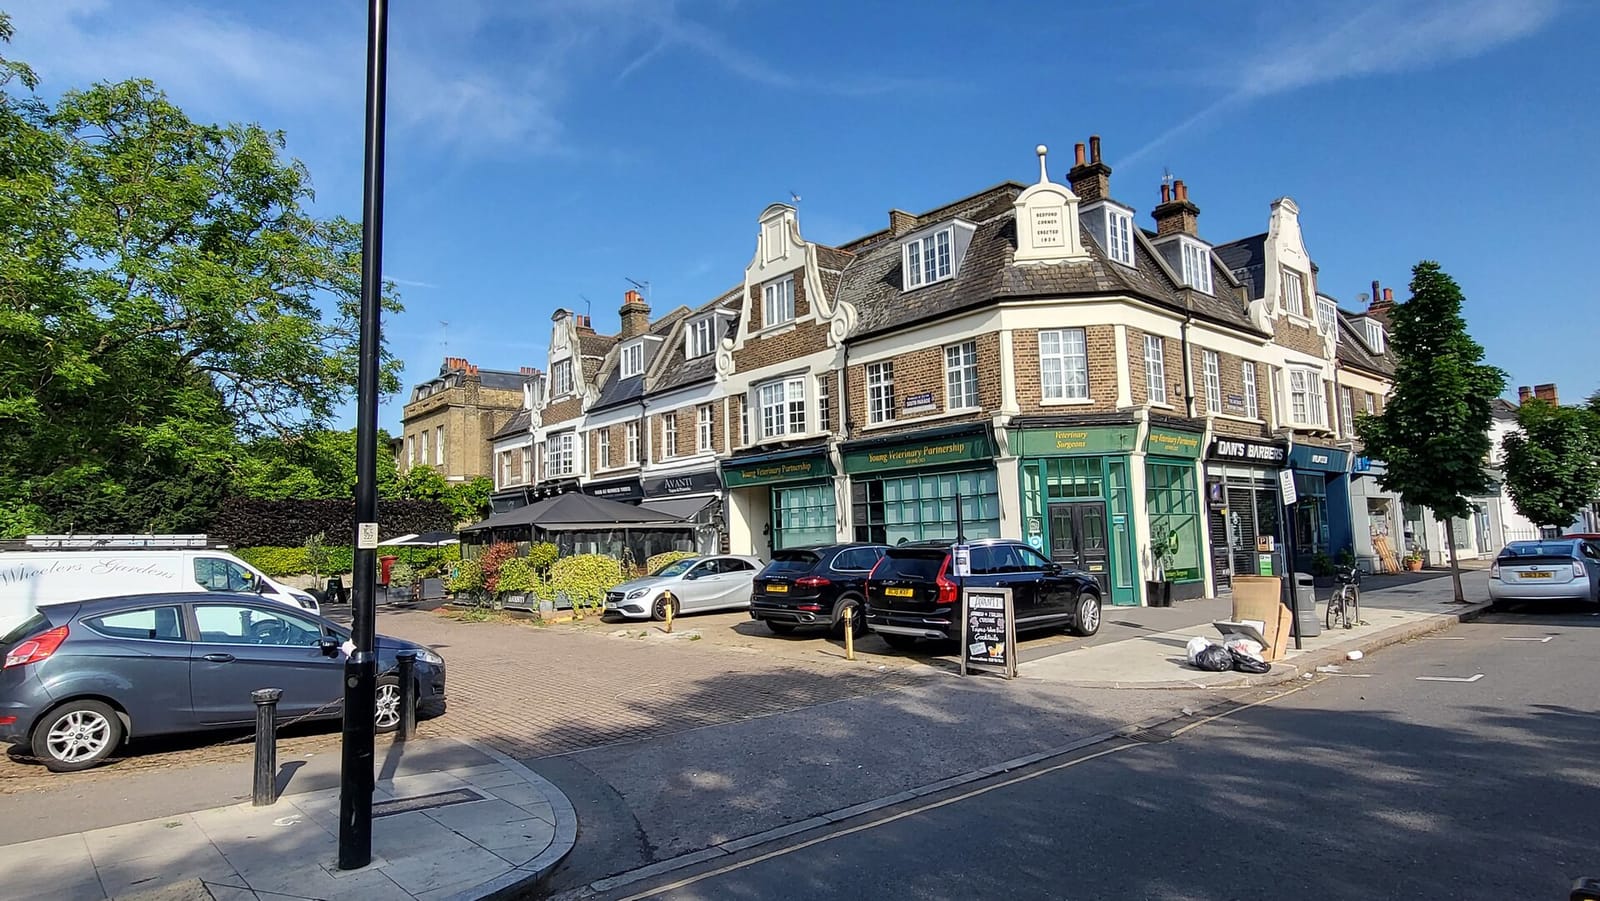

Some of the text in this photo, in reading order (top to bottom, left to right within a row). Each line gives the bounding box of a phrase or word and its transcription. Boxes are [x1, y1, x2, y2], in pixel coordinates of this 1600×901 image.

[1055, 431, 1088, 440] Veterinary
[1056, 440, 1087, 449] Surgeons
[1217, 441, 1284, 460] DAN'S BARBERS
[868, 442, 965, 463] Young Veterinary Partnership
[781, 461, 812, 473] Partnership
[664, 477, 693, 489] AVANTI
[90, 558, 174, 580] Gardens
